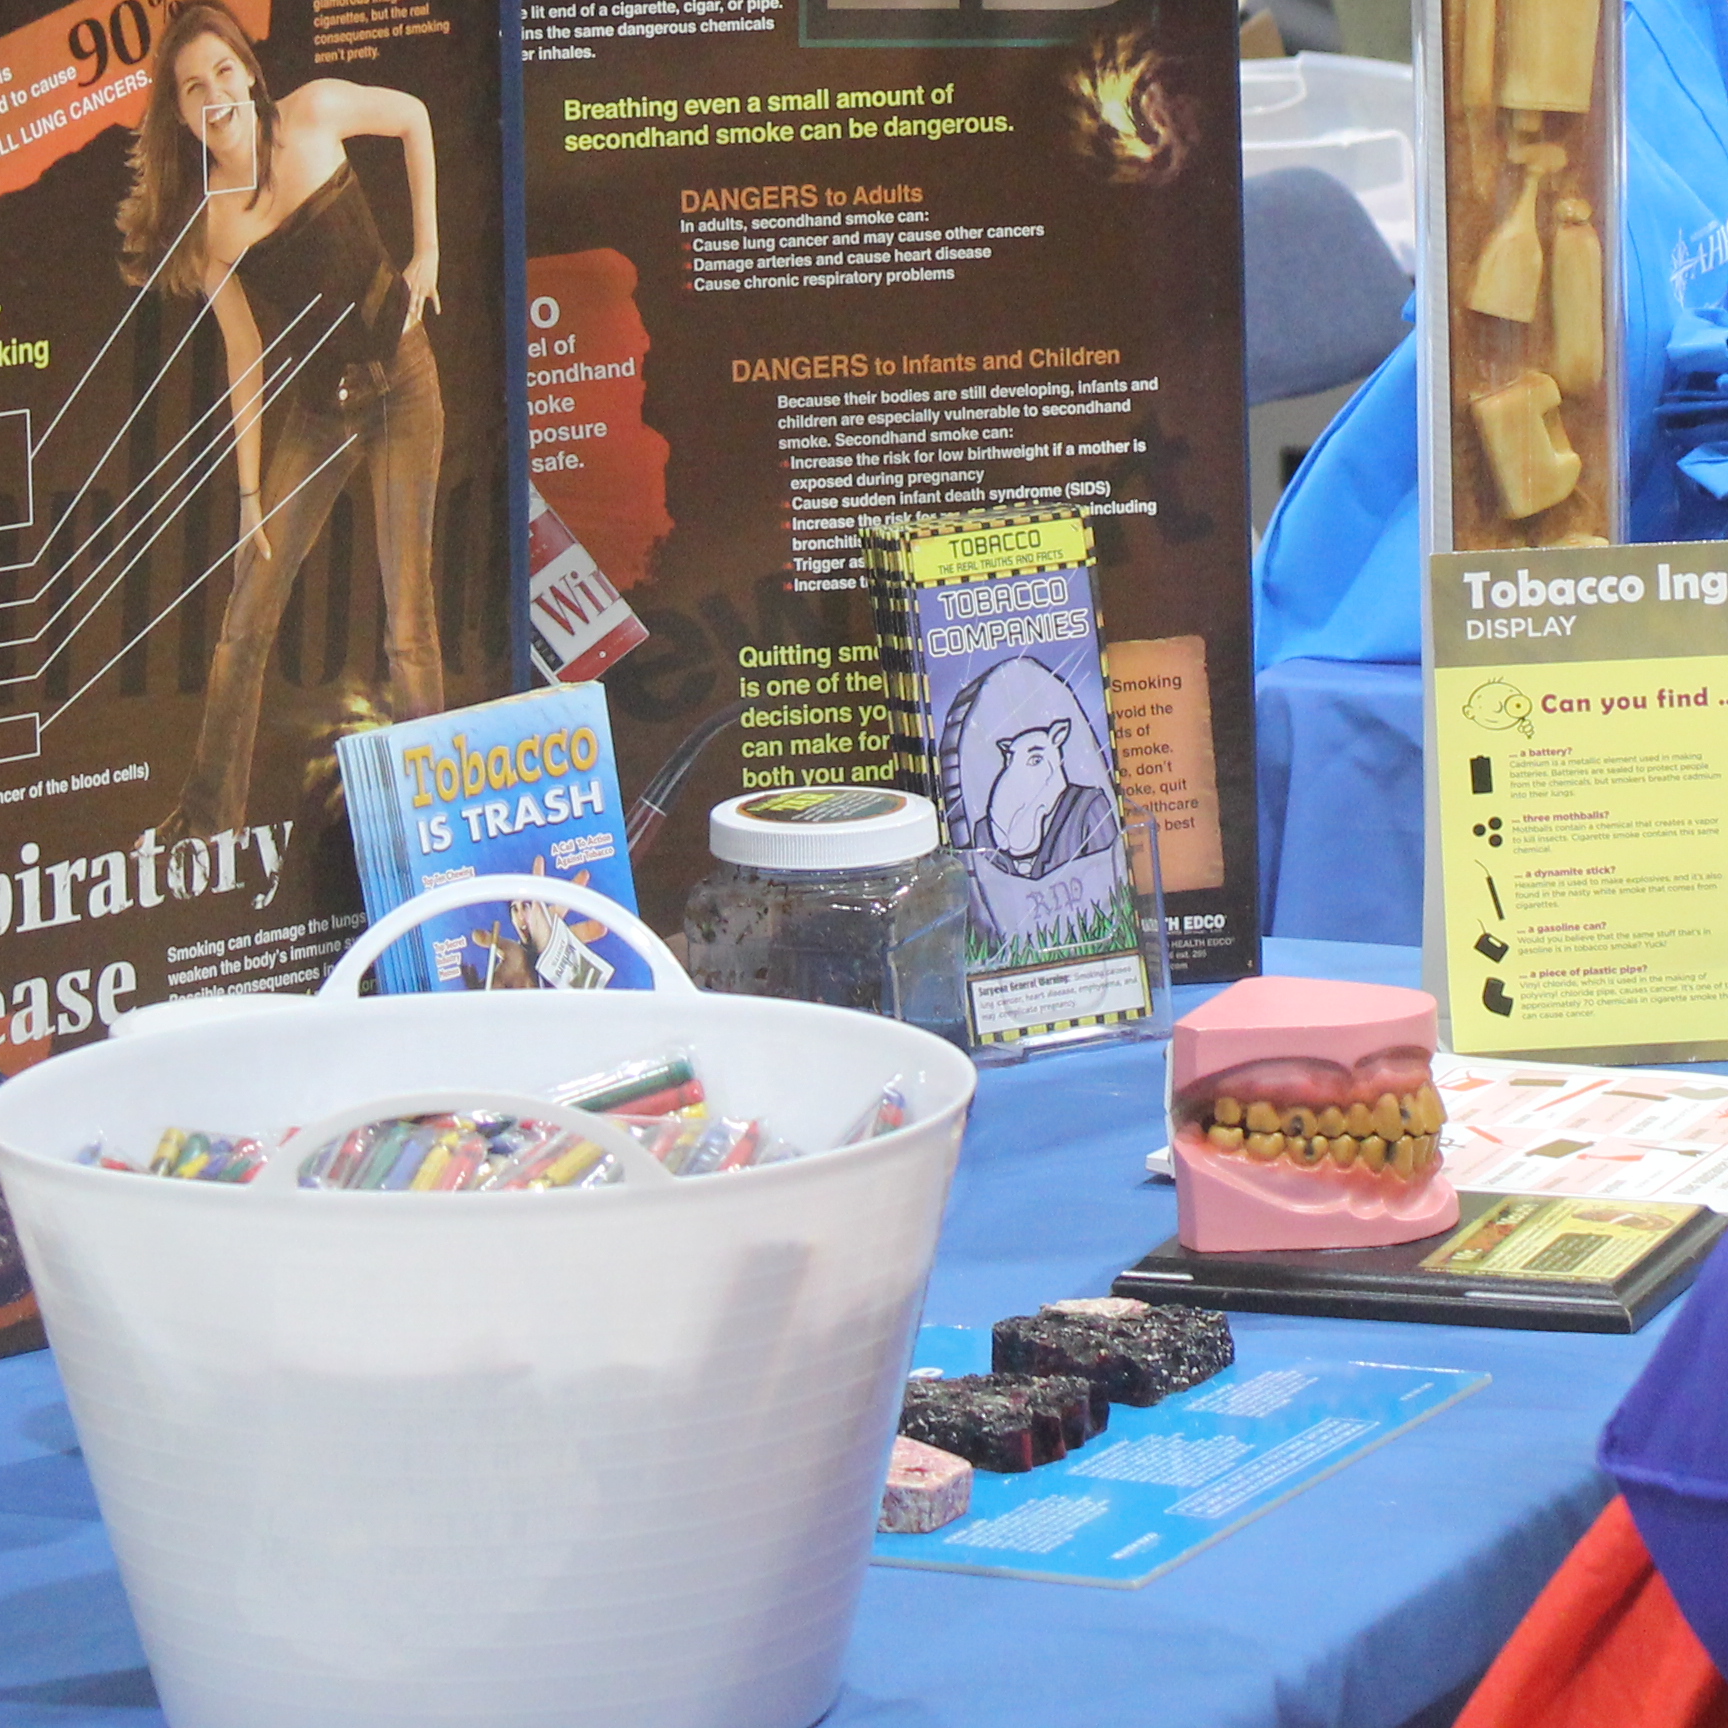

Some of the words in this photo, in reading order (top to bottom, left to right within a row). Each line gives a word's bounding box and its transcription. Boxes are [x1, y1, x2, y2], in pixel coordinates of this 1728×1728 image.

[10, 87, 28, 107] to
[30, 64, 77, 99] cause
[20, 110, 68, 149] LUNG
[71, 69, 153, 122] CANCERS.
[564, 96, 678, 123] Breathing
[684, 97, 741, 117] even
[746, 96, 761, 114] a
[767, 89, 829, 113] small
[835, 86, 926, 111] amount
[930, 82, 955, 105] of
[564, 124, 709, 152] secondhand
[715, 121, 795, 146] smoke
[800, 122, 842, 142] can
[848, 117, 878, 139] be
[883, 113, 1015, 141] dangerous.
[680, 184, 820, 214] DANGERS
[825, 186, 848, 208] to
[853, 183, 924, 206] Adults
[731, 353, 869, 384] DANGERS
[874, 356, 897, 376] to
[902, 352, 977, 374] Infants
[983, 350, 1023, 371] and
[1029, 345, 1121, 370] Children
[531, 451, 585, 473] safe.
[949, 529, 1042, 559] TOBACCO
[938, 564, 955, 575] THE
[957, 561, 978, 572] REAL
[980, 555, 1013, 570] TRUTHS
[1016, 553, 1034, 565] AND
[1036, 549, 1064, 562] FACTS
[937, 576, 1069, 621] TOBACCO
[1462, 568, 1645, 610] Tobacco
[927, 608, 1089, 658] COMPANIES
[1465, 615, 1577, 640] DISPLAY
[739, 644, 832, 669] Quitting
[740, 677, 760, 698] is
[766, 678, 811, 696] one
[816, 672, 840, 694] of
[846, 671, 883, 693] the
[1112, 675, 1183, 693] Smoking
[741, 704, 853, 728] decisions
[1541, 693, 1591, 715] Can
[1601, 694, 1648, 716] you
[1657, 687, 1708, 708] find
[741, 739, 783, 758] can
[790, 733, 853, 756] make
[858, 731, 891, 752] for
[1529, 747, 1572, 758] battery?
[403, 726, 600, 809] Tobacco
[742, 765, 795, 788] both
[802, 768, 845, 786] you
[851, 759, 895, 782] and
[417, 813, 453, 855] IS
[460, 777, 605, 843] TRASH
[1523, 814, 1550, 822] three
[1553, 810, 1609, 821] mothballs?
[1534, 868, 1583, 879] dynamite
[1586, 866, 1616, 875] stick?
[167, 940, 225, 963] Smoking
[228, 935, 252, 951] can
[254, 925, 306, 946] damage
[308, 918, 328, 935] the
[331, 911, 366, 929] lungs
[1184, 914, 1226, 931] EDCO
[1537, 924, 1580, 934] gasoline
[1583, 922, 1606, 931] can?
[1539, 968, 1566, 979] piece
[1583, 966, 1617, 977] plastic
[1619, 964, 1648, 975] pipe?
